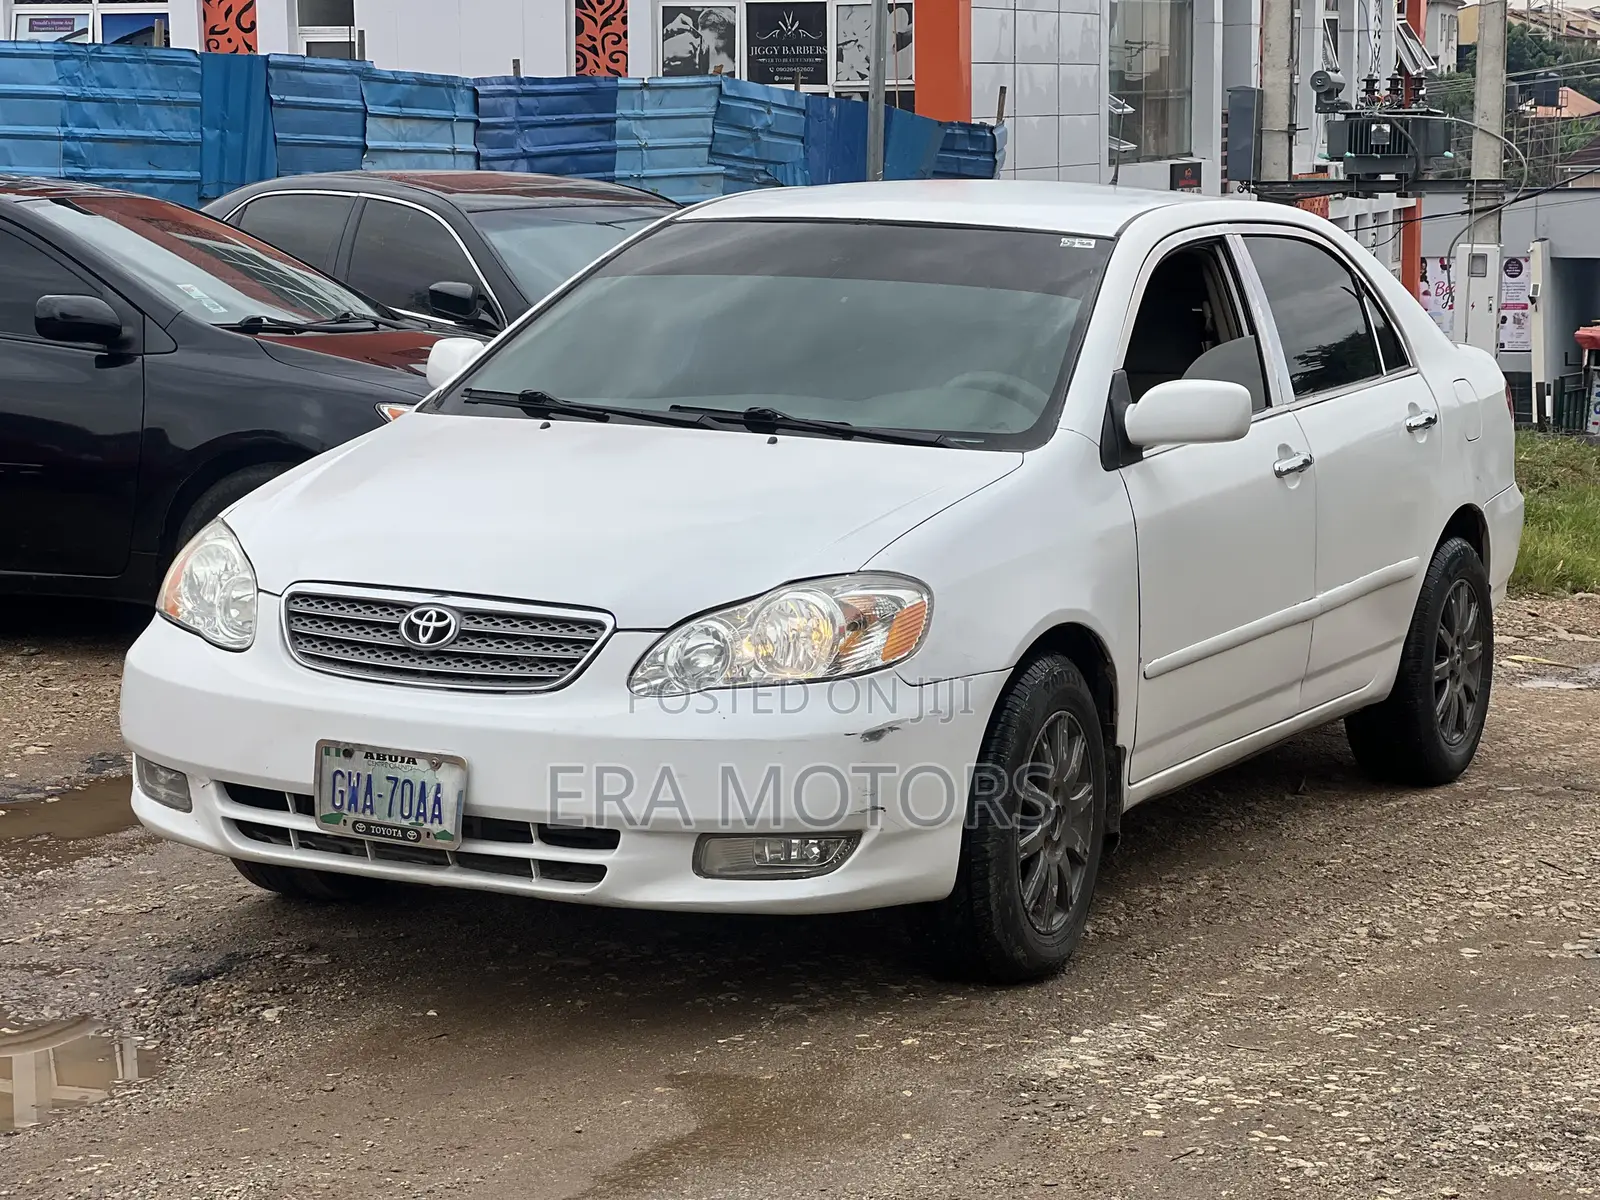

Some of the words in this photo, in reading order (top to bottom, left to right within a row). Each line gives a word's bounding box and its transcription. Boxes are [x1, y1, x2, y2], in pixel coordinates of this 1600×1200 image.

[749, 46, 779, 56] JIGGY
[782, 46, 828, 55] BARBERS
[363, 751, 418, 765] ABUJA
[370, 825, 402, 838] TOYOTA
